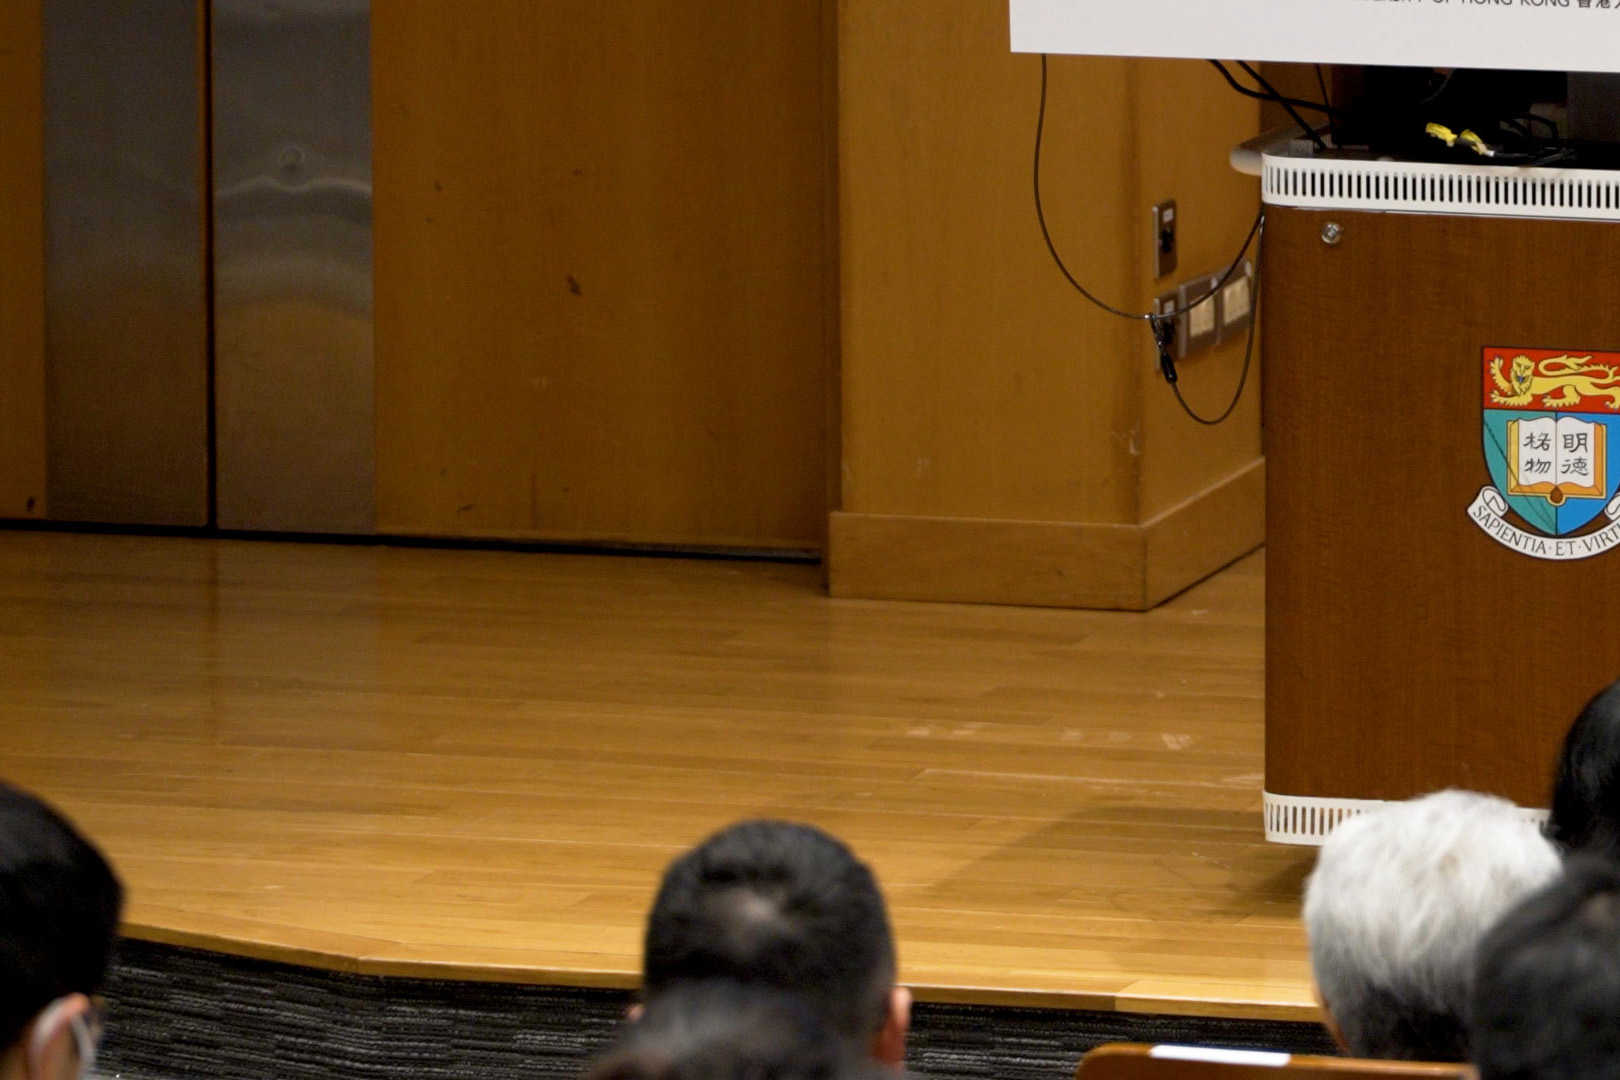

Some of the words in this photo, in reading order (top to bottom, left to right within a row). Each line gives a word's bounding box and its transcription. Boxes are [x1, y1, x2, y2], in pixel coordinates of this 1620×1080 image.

[1561, 432, 1589, 476] 明德
[1472, 504, 1547, 555] SAPIENTIA
[1555, 541, 1576, 556] ET
